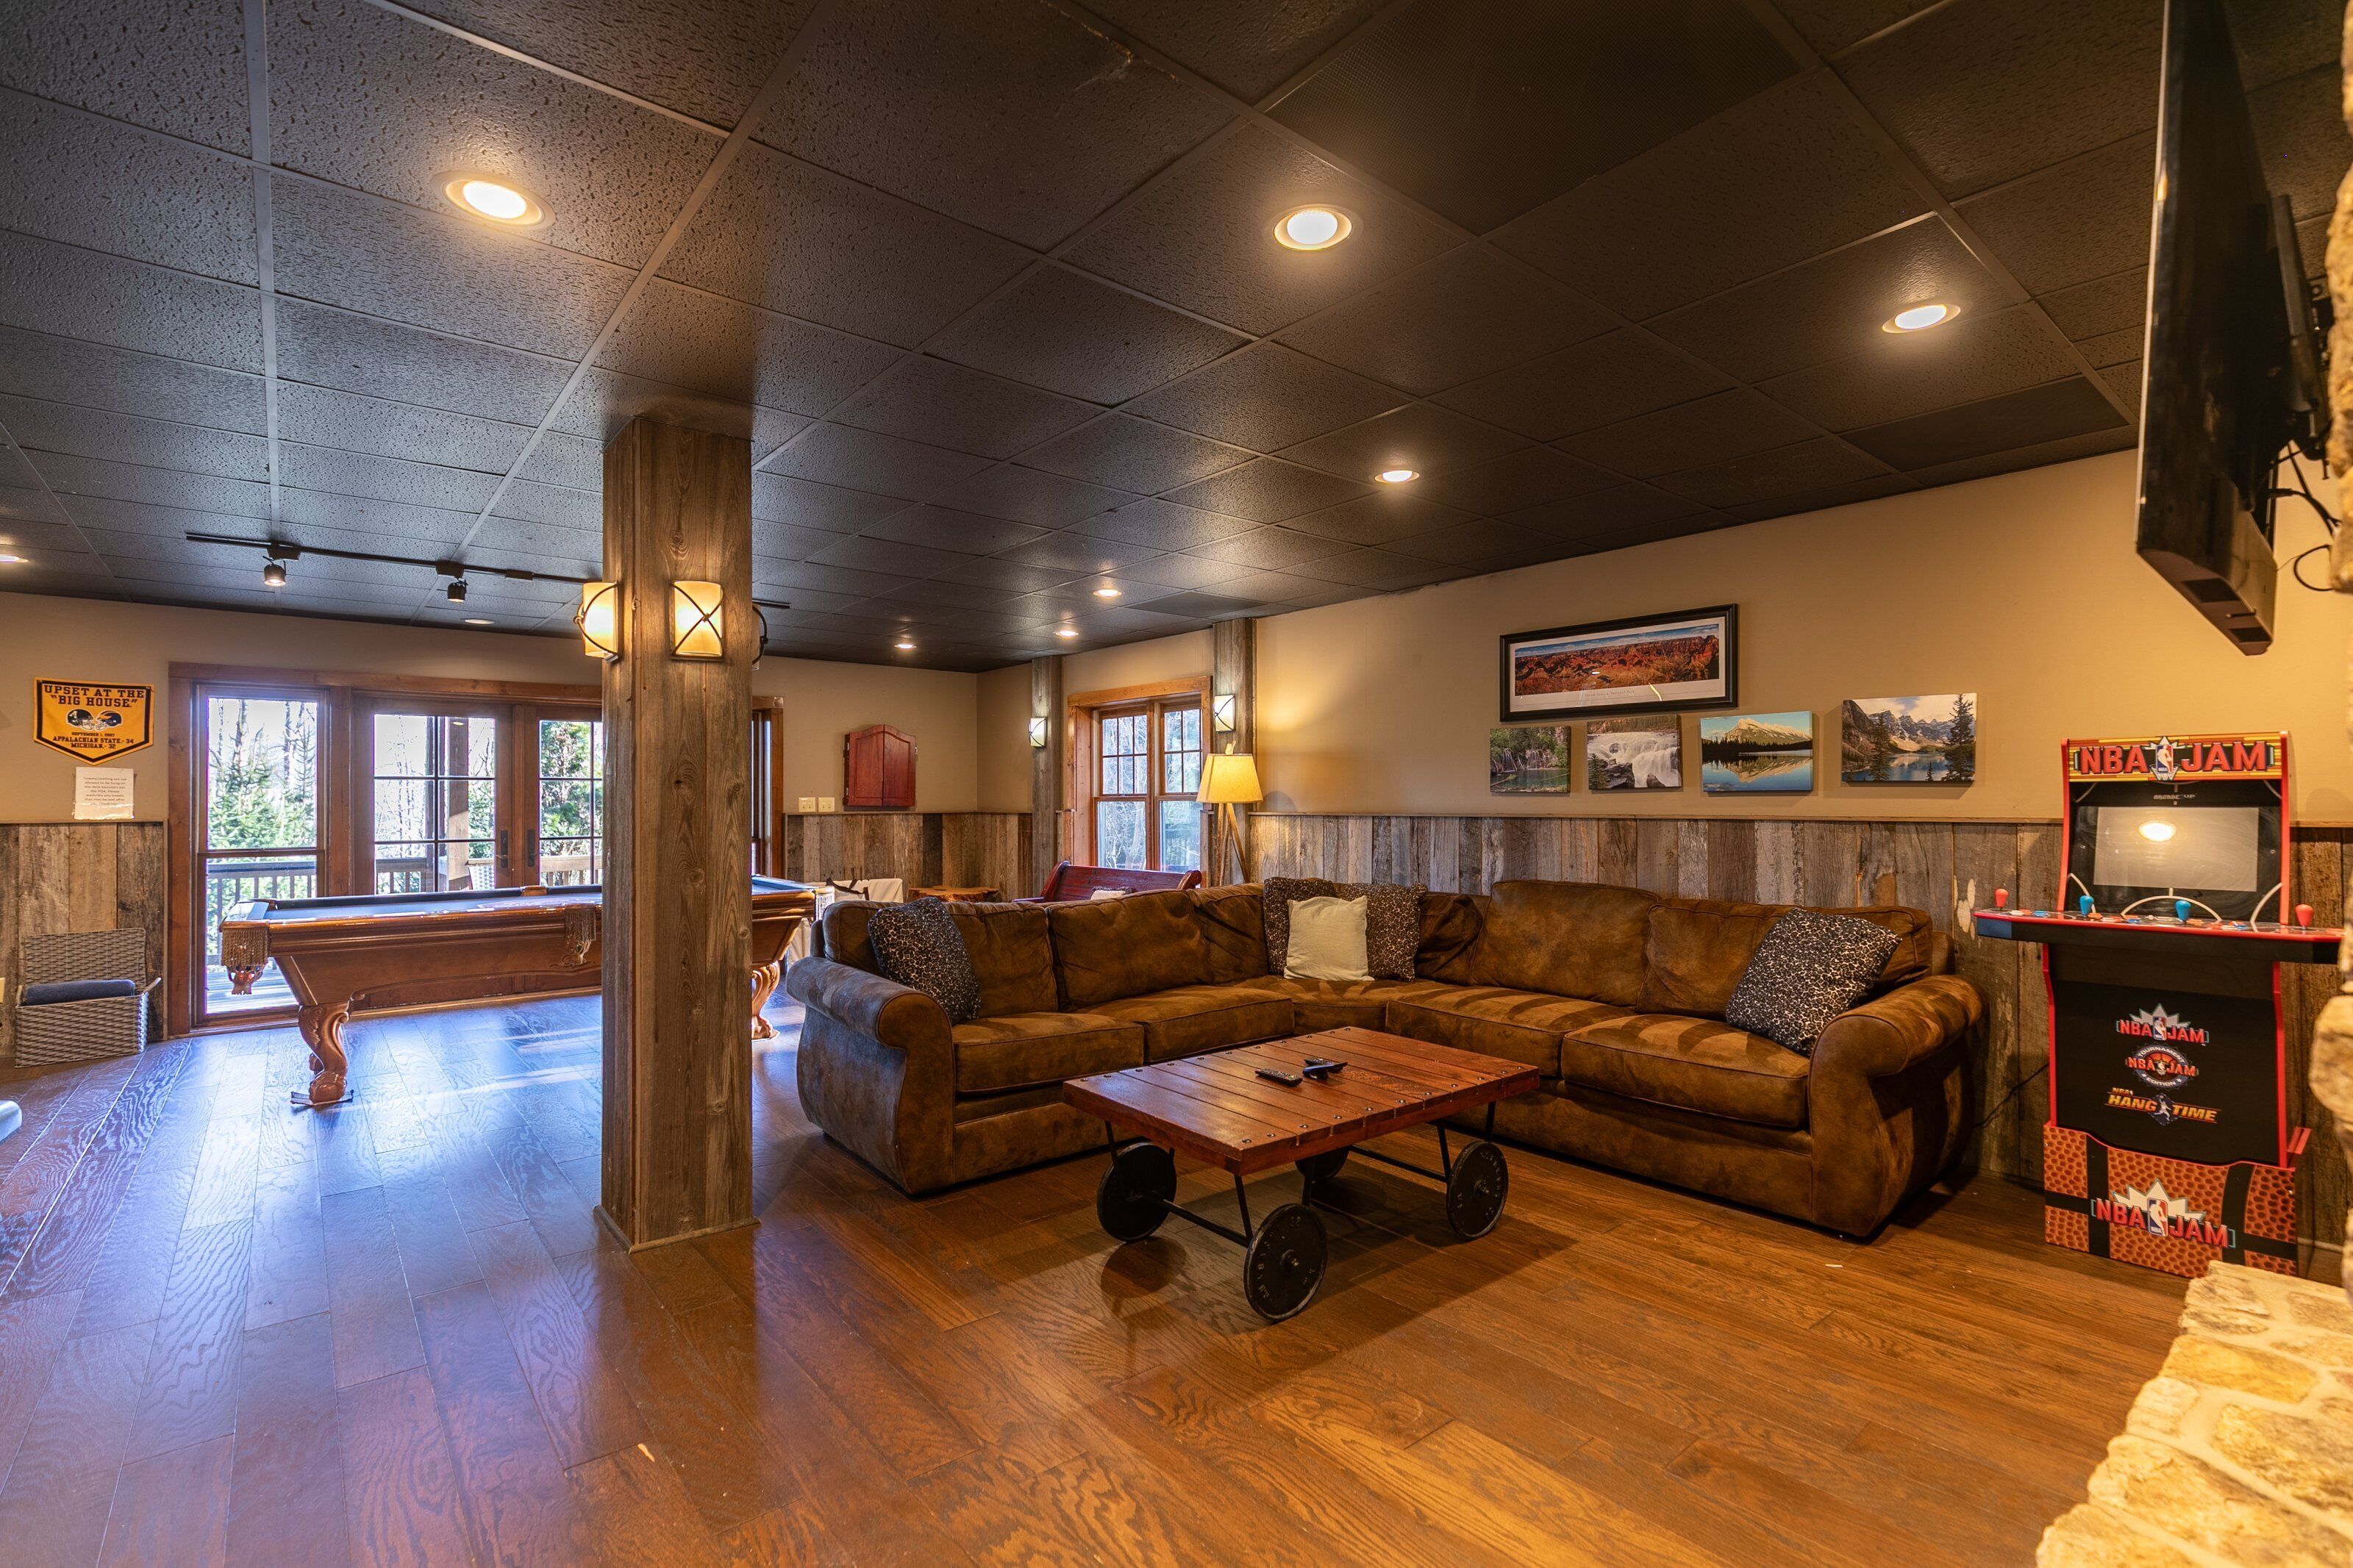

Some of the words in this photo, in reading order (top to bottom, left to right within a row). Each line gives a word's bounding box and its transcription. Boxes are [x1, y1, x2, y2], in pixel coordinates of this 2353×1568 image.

[44, 684, 90, 696] UPSET
[94, 689, 112, 697] AT
[118, 690, 144, 698] THE
[2080, 745, 2150, 774] NBA
[2181, 741, 2267, 772] JAM
[2118, 1019, 2153, 1038] NBA
[2167, 1025, 2205, 1044] JAM
[2138, 1045, 2185, 1064] TOURNAMENT
[2127, 1056, 2156, 1072] NBA
[2166, 1062, 2196, 1077] JAM
[2146, 1076, 2177, 1087] EDITION
[2107, 1094, 2158, 1112] HANG
[2172, 1103, 2218, 1122] TIME
[2096, 1198, 2147, 1231] NBA
[2169, 1214, 2228, 1249] JAM
